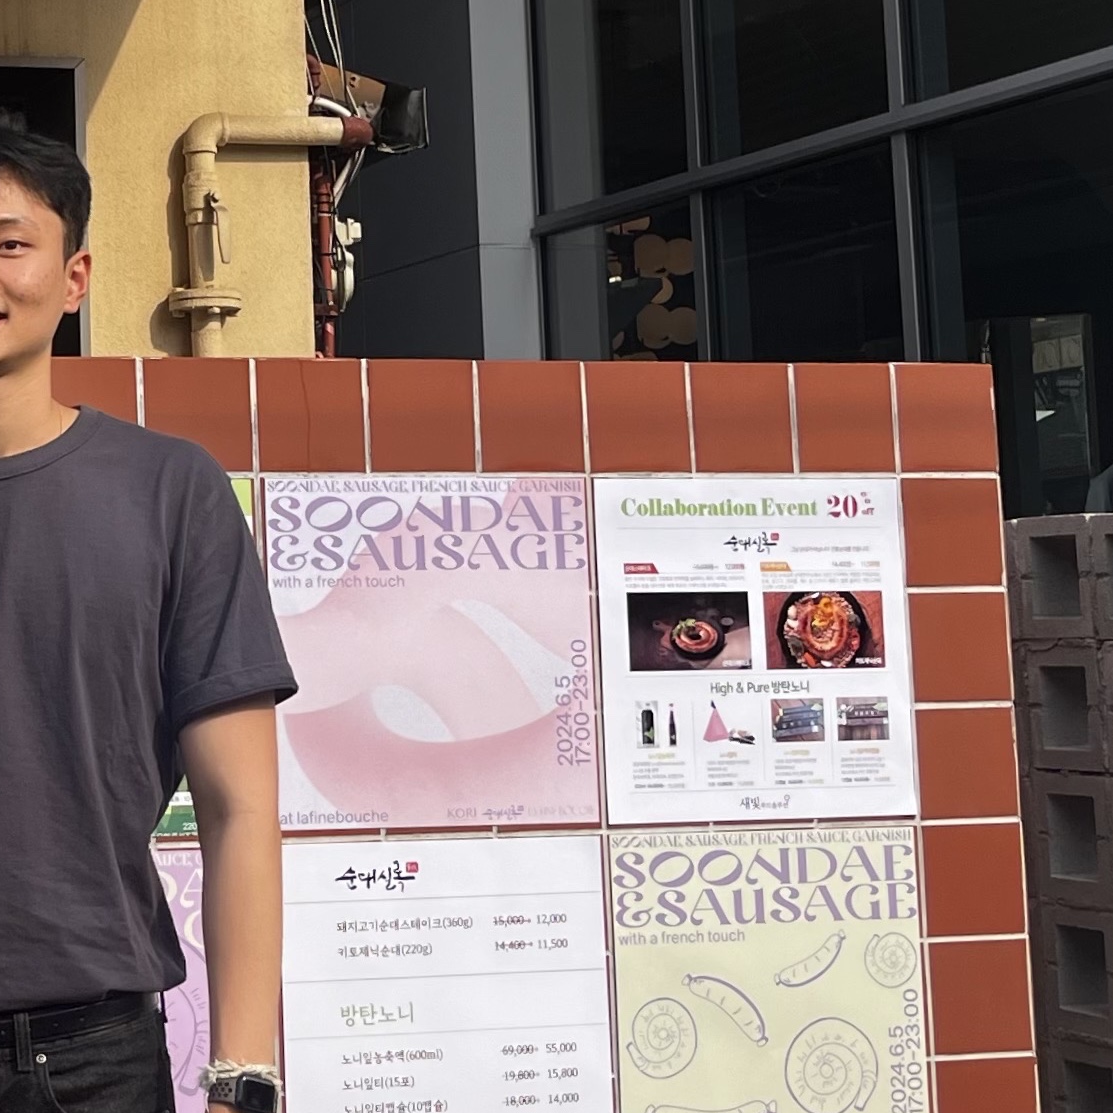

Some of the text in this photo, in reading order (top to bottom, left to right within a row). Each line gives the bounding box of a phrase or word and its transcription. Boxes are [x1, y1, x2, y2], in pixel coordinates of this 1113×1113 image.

[412, 480, 467, 493] FRENCH
[621, 498, 758, 517] Collaboration
[760, 497, 817, 517] Event
[826, 495, 858, 518] 20
[268, 495, 583, 533] SOONDAE
[273, 575, 405, 588] with a french touch
[710, 680, 810, 696] High & Pure 방탄노니
[555, 675, 573, 766] 2024.6.5
[280, 809, 389, 825] at lafinebouche
[447, 808, 477, 819] KORI
[750, 832, 803, 845] FRENCH
[613, 844, 914, 888] SOONDAE
[536, 913, 567, 926] 12,000
[538, 938, 568, 950] 11,500
[619, 930, 745, 946] with a french touch
[340, 1001, 414, 1027] 방탄노니
[546, 1042, 577, 1055] 55,000
[548, 1067, 578, 1080] 15,800
[549, 1093, 579, 1105] 14,000
